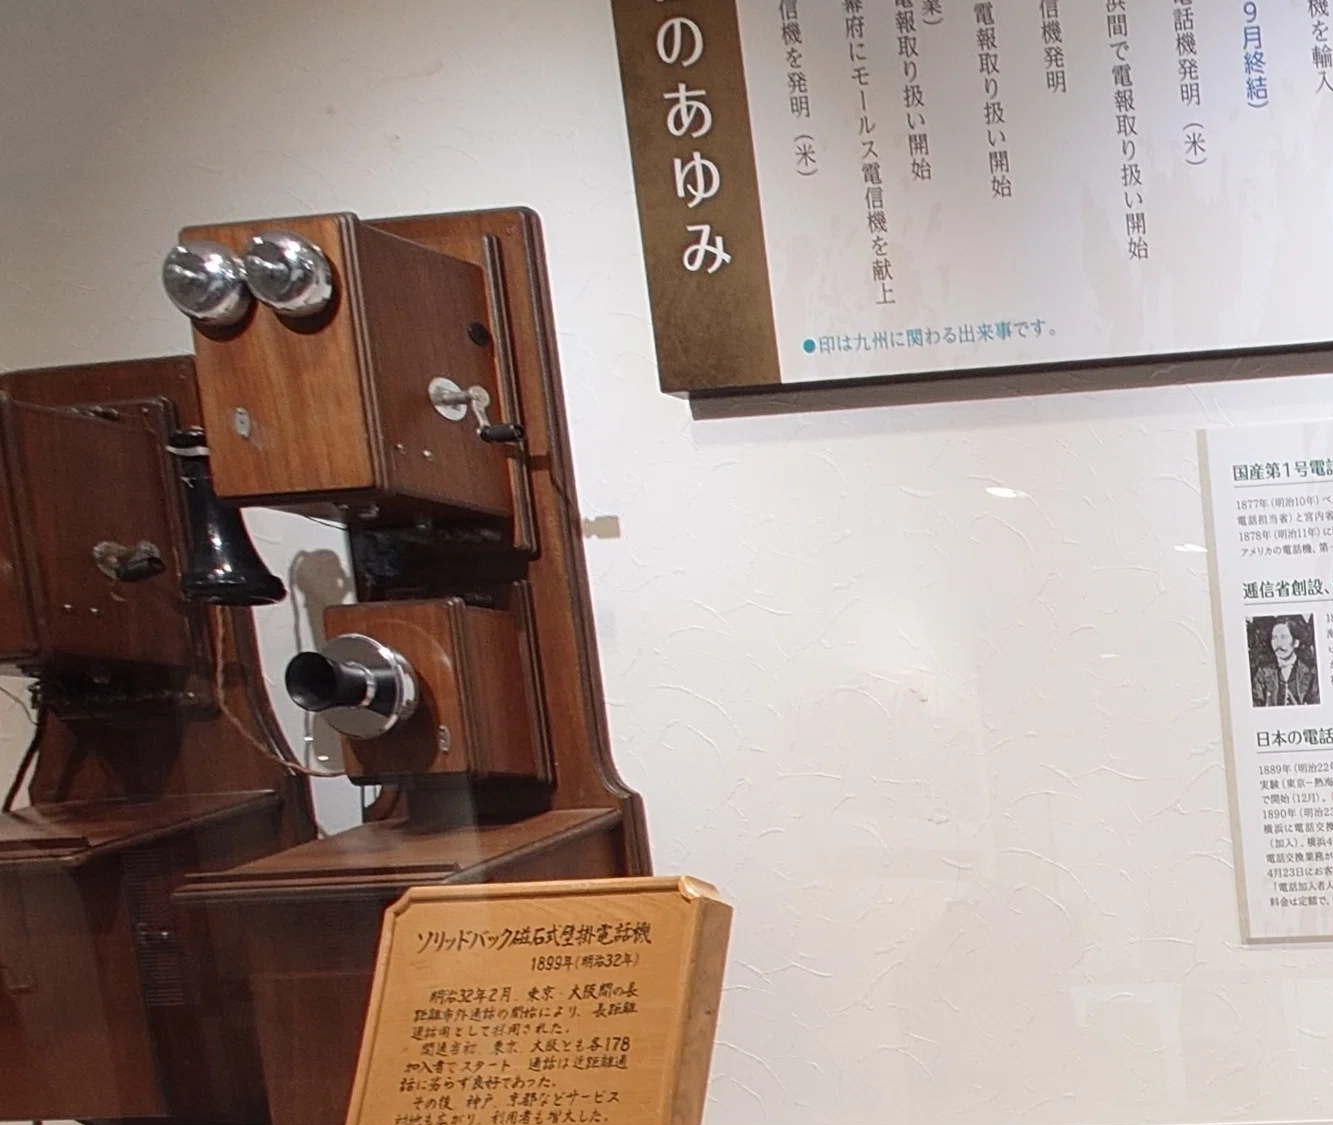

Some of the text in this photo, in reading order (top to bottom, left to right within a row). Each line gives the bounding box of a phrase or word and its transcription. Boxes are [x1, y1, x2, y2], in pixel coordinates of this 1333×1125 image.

[1039, 0, 1067, 93] 信機発明
[974, 2, 1012, 199] 電報取り扱い開始
[652, 0, 732, 275] のあゆみ
[819, 319, 1056, 355] 印は九州に関わる出来事です。
[416, 922, 652, 955] ソリッドバック磁石式壁掛電話機
[530, 952, 640, 972] 1899年(明治32年)
